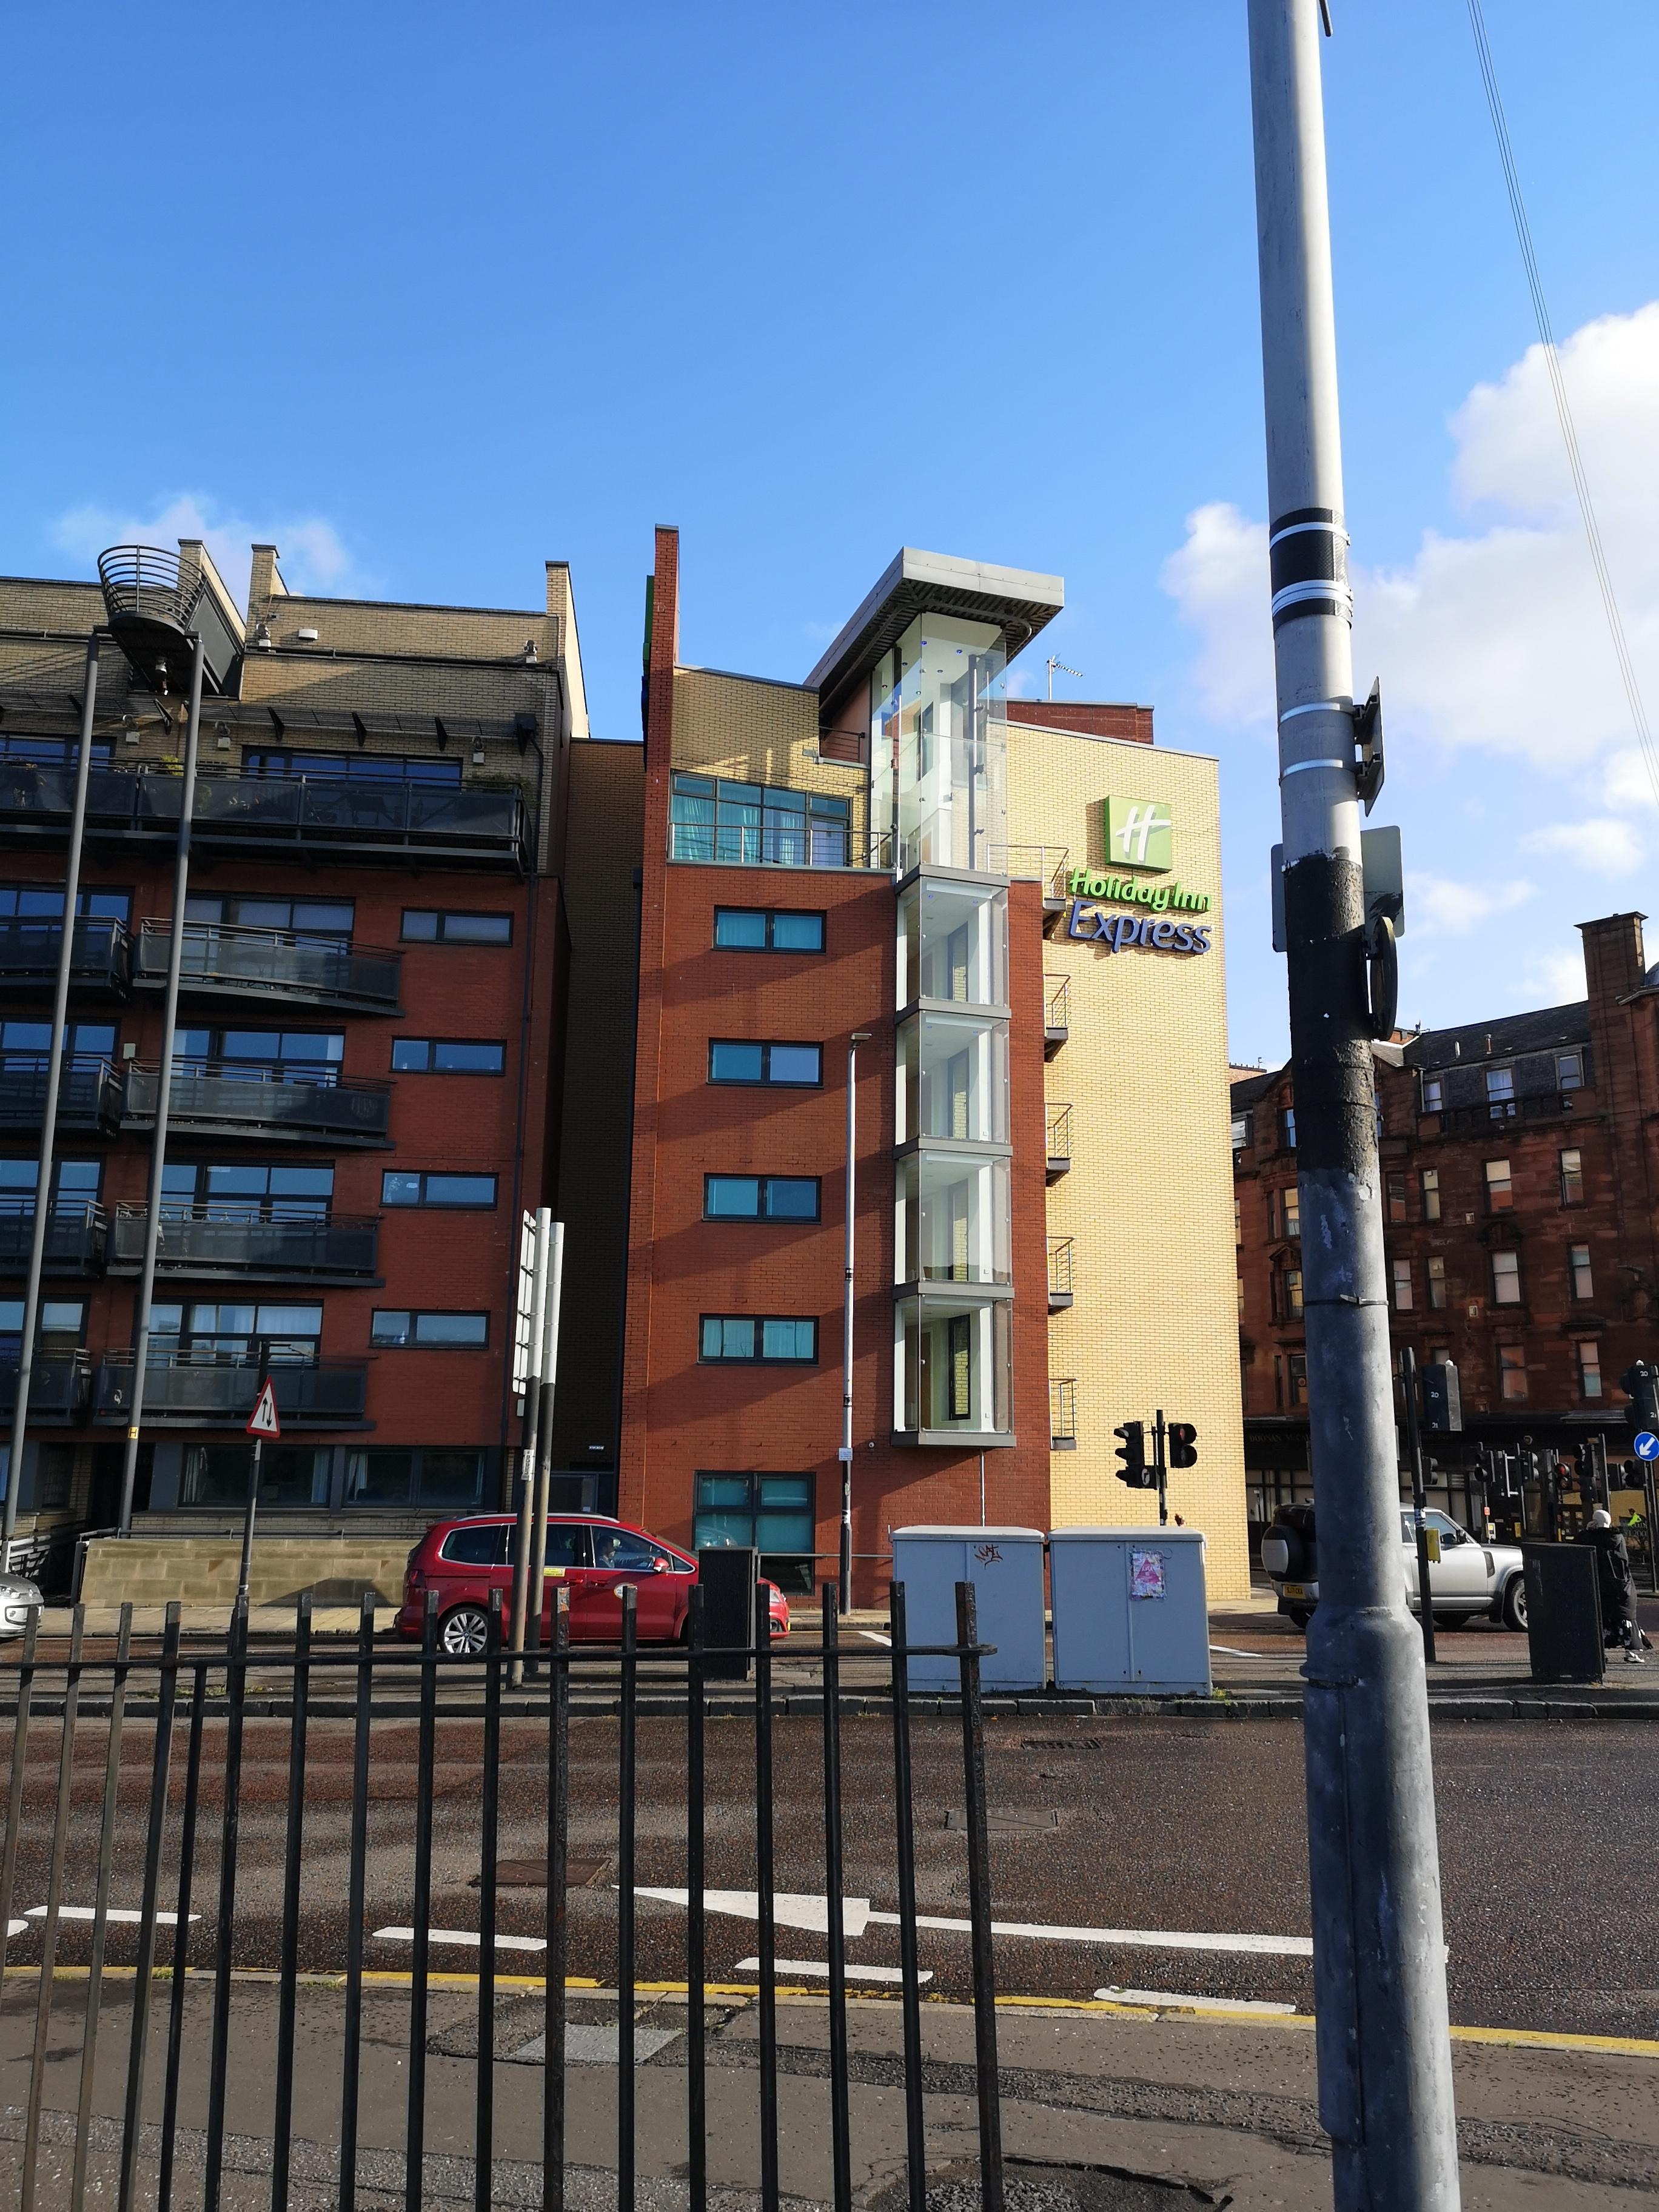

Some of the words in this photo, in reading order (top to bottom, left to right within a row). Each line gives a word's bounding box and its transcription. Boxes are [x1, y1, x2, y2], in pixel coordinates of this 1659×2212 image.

[1069, 866, 1169, 912] Holiday
[1173, 882, 1212, 911] Inn
[1070, 900, 1212, 953] Express
[129, 1427, 138, 1437] H
